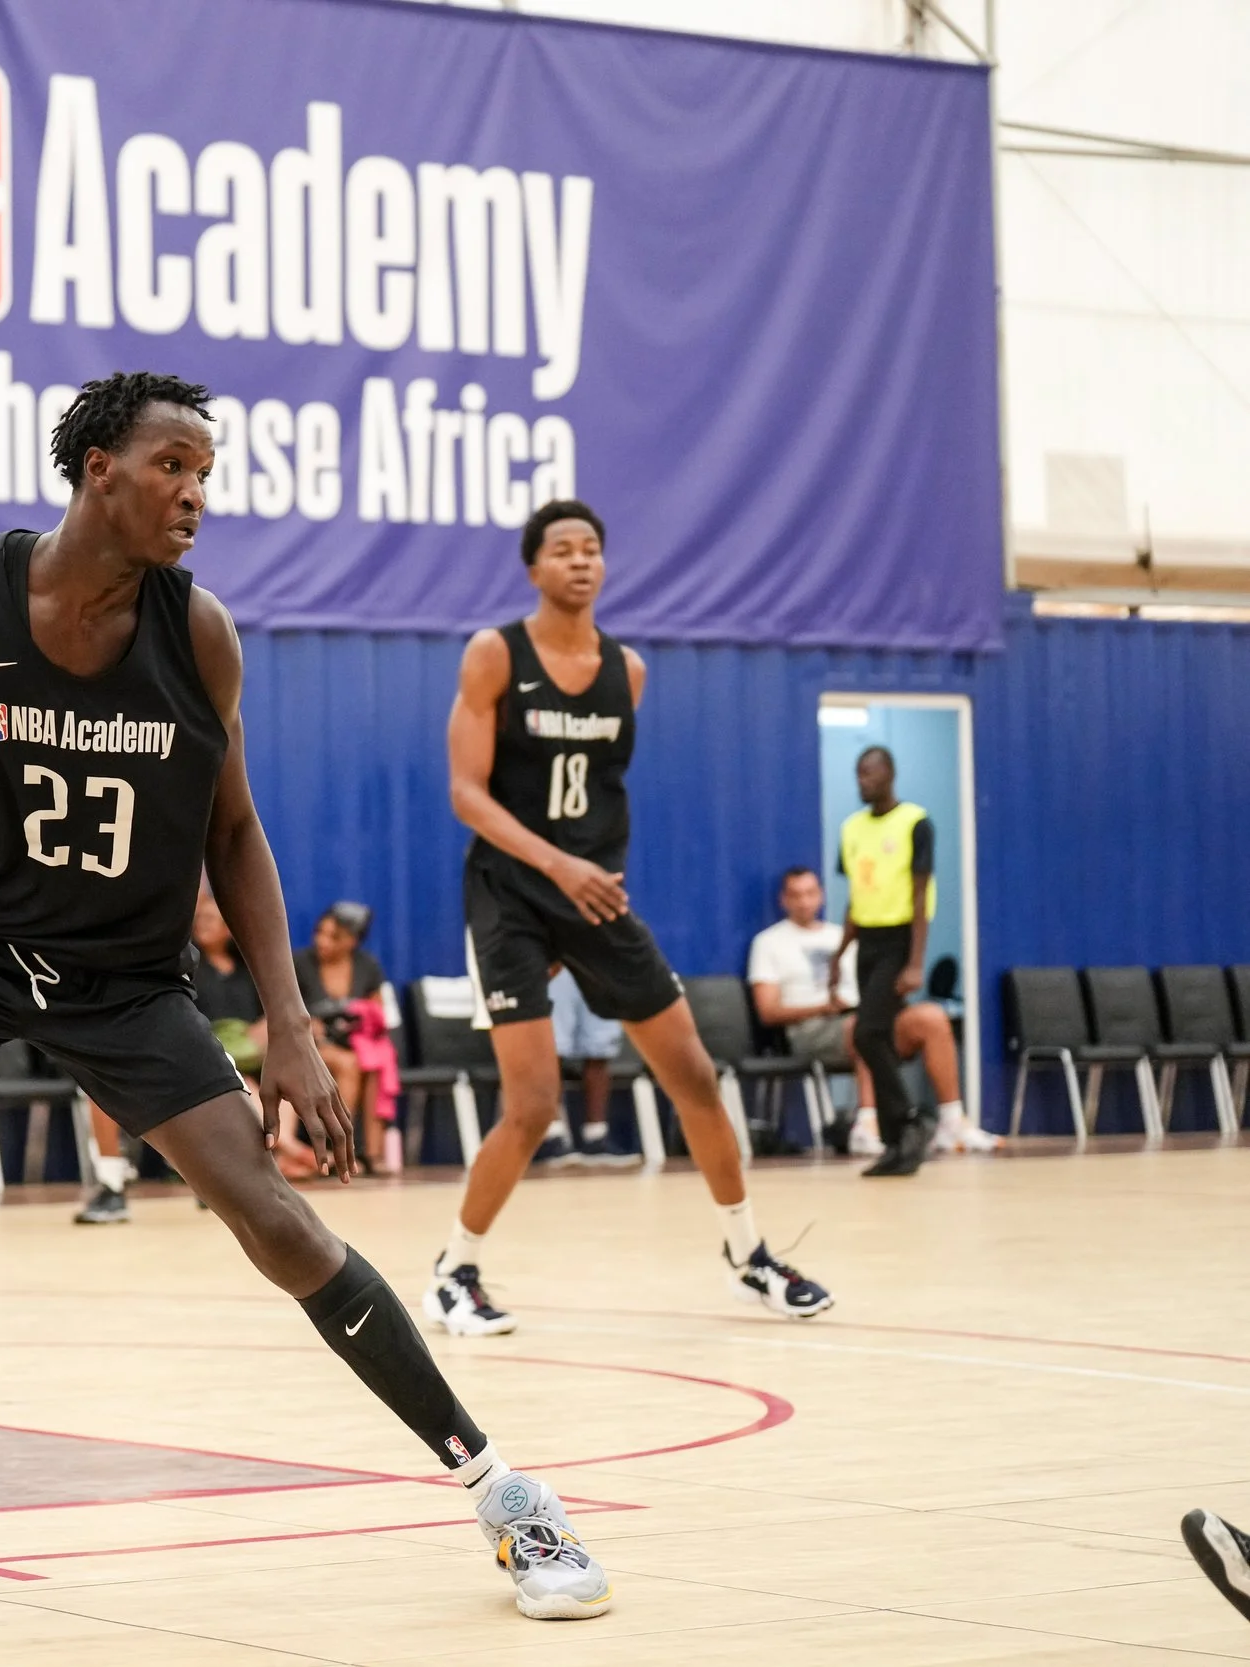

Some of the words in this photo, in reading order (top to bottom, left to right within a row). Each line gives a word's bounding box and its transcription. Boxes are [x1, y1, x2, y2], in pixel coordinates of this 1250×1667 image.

[29, 73, 594, 401] Academy
[357, 376, 577, 530] Africa
[11, 705, 57, 746] NBA
[60, 710, 175, 759] Academy
[547, 752, 589, 820] 18
[23, 764, 135, 877] 23
